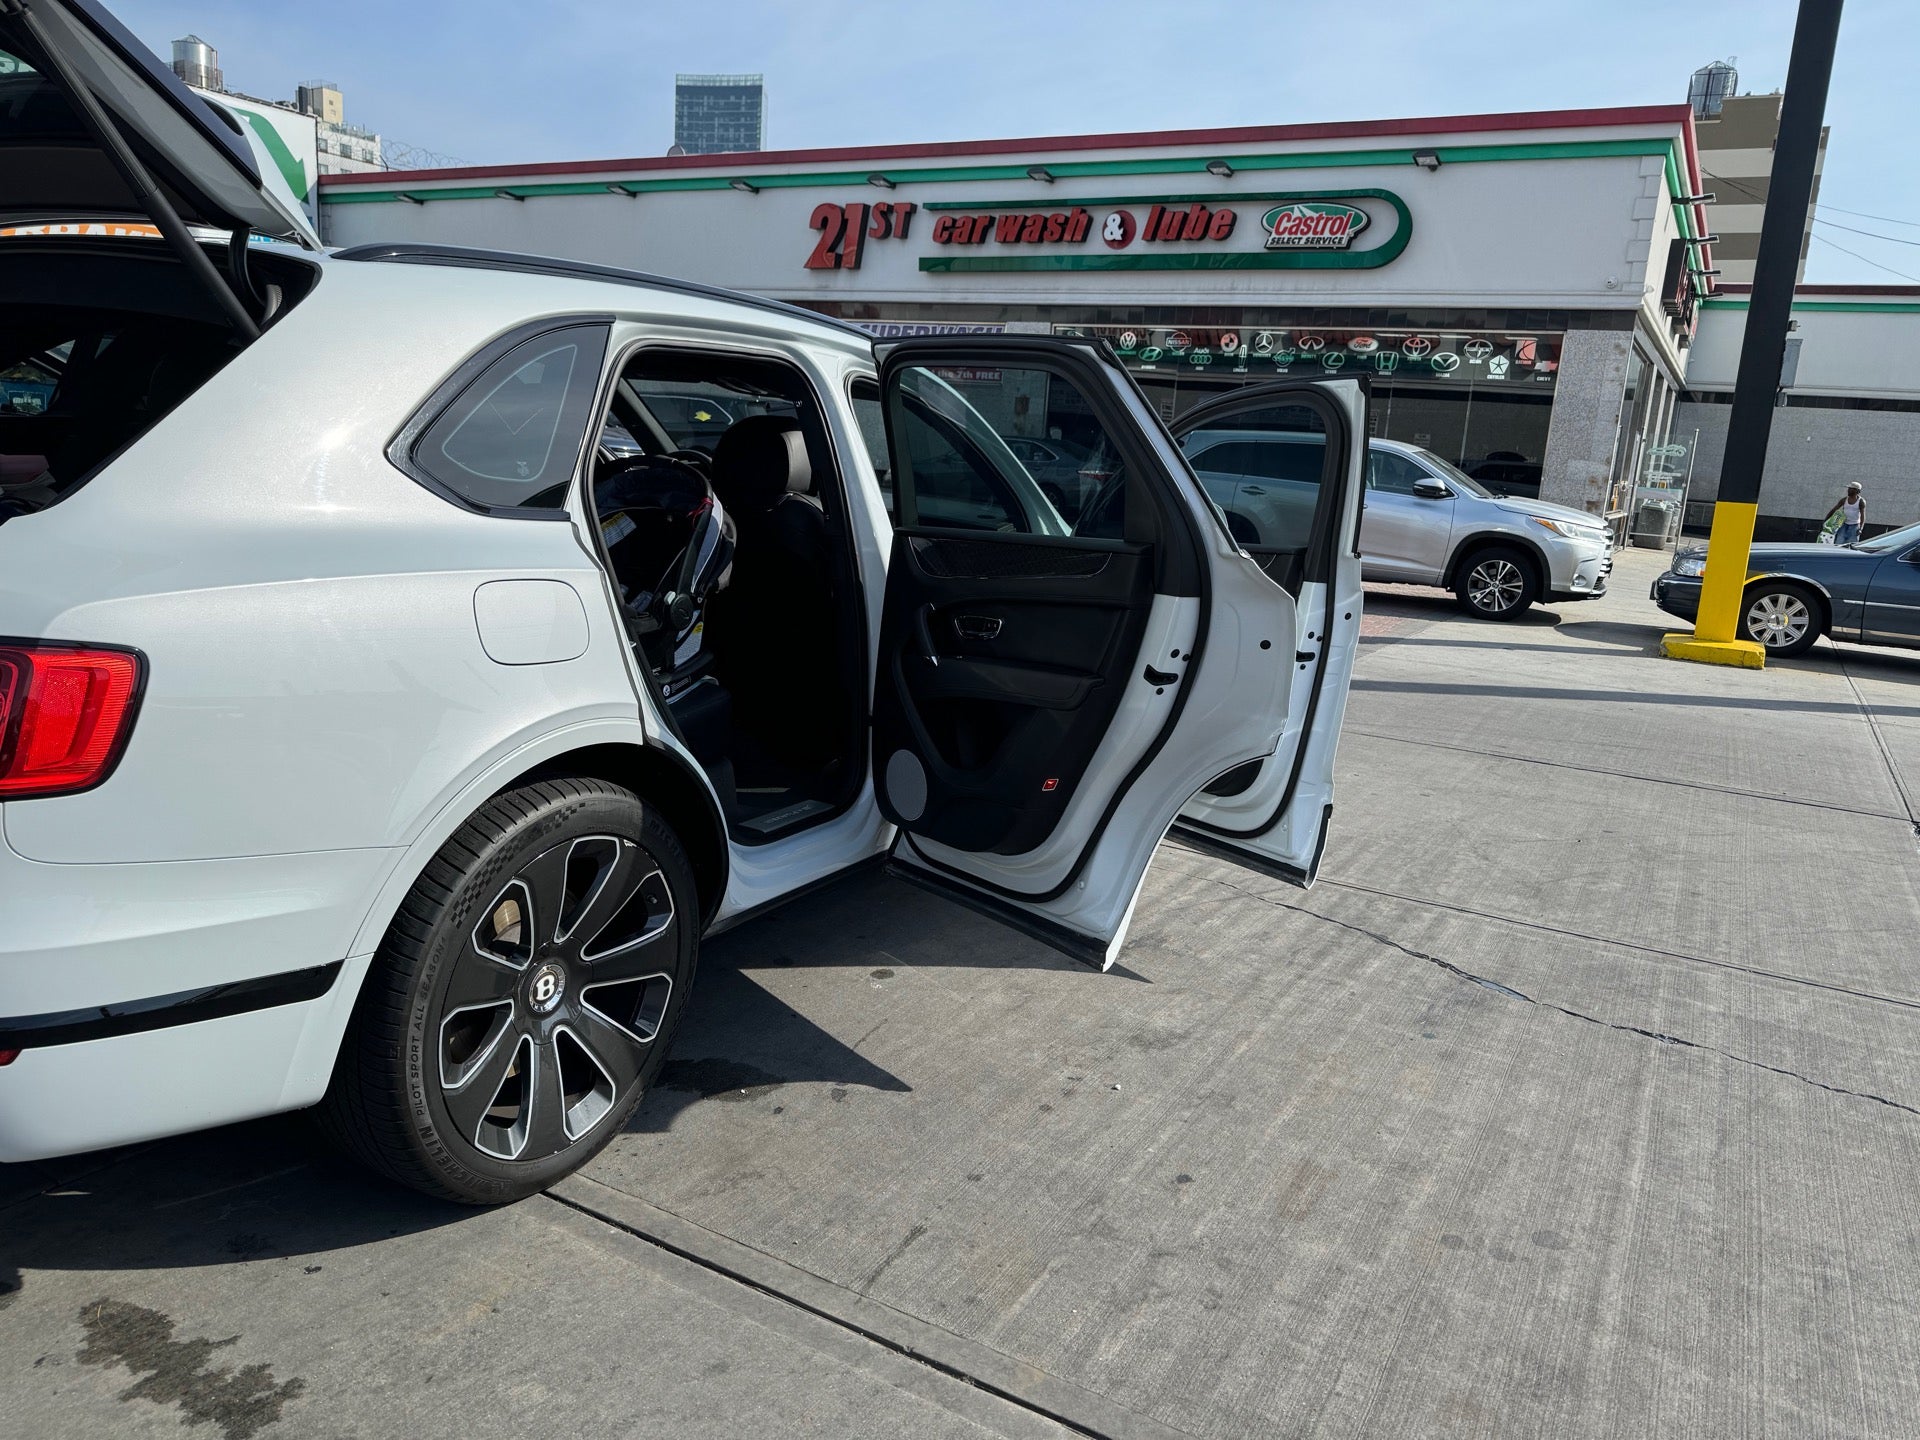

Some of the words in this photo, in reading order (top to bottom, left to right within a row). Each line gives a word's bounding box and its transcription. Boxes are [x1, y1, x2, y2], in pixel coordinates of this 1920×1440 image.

[932, 215, 995, 245] car
[994, 207, 1093, 244] wash
[1103, 213, 1124, 241] &
[1142, 204, 1237, 242] lube
[1273, 210, 1354, 237] Castrol
[1269, 236, 1303, 245] SELECT
[1304, 236, 1344, 245] SERVICE
[1167, 338, 1190, 346] NISSAN
[975, 371, 1001, 380] FREE
[420, 943, 445, 1000] SEASON
[535, 973, 555, 1001] B
[415, 1004, 426, 1031] ALL
[411, 1035, 421, 1079] SPORT
[411, 1084, 425, 1116] PILOT
